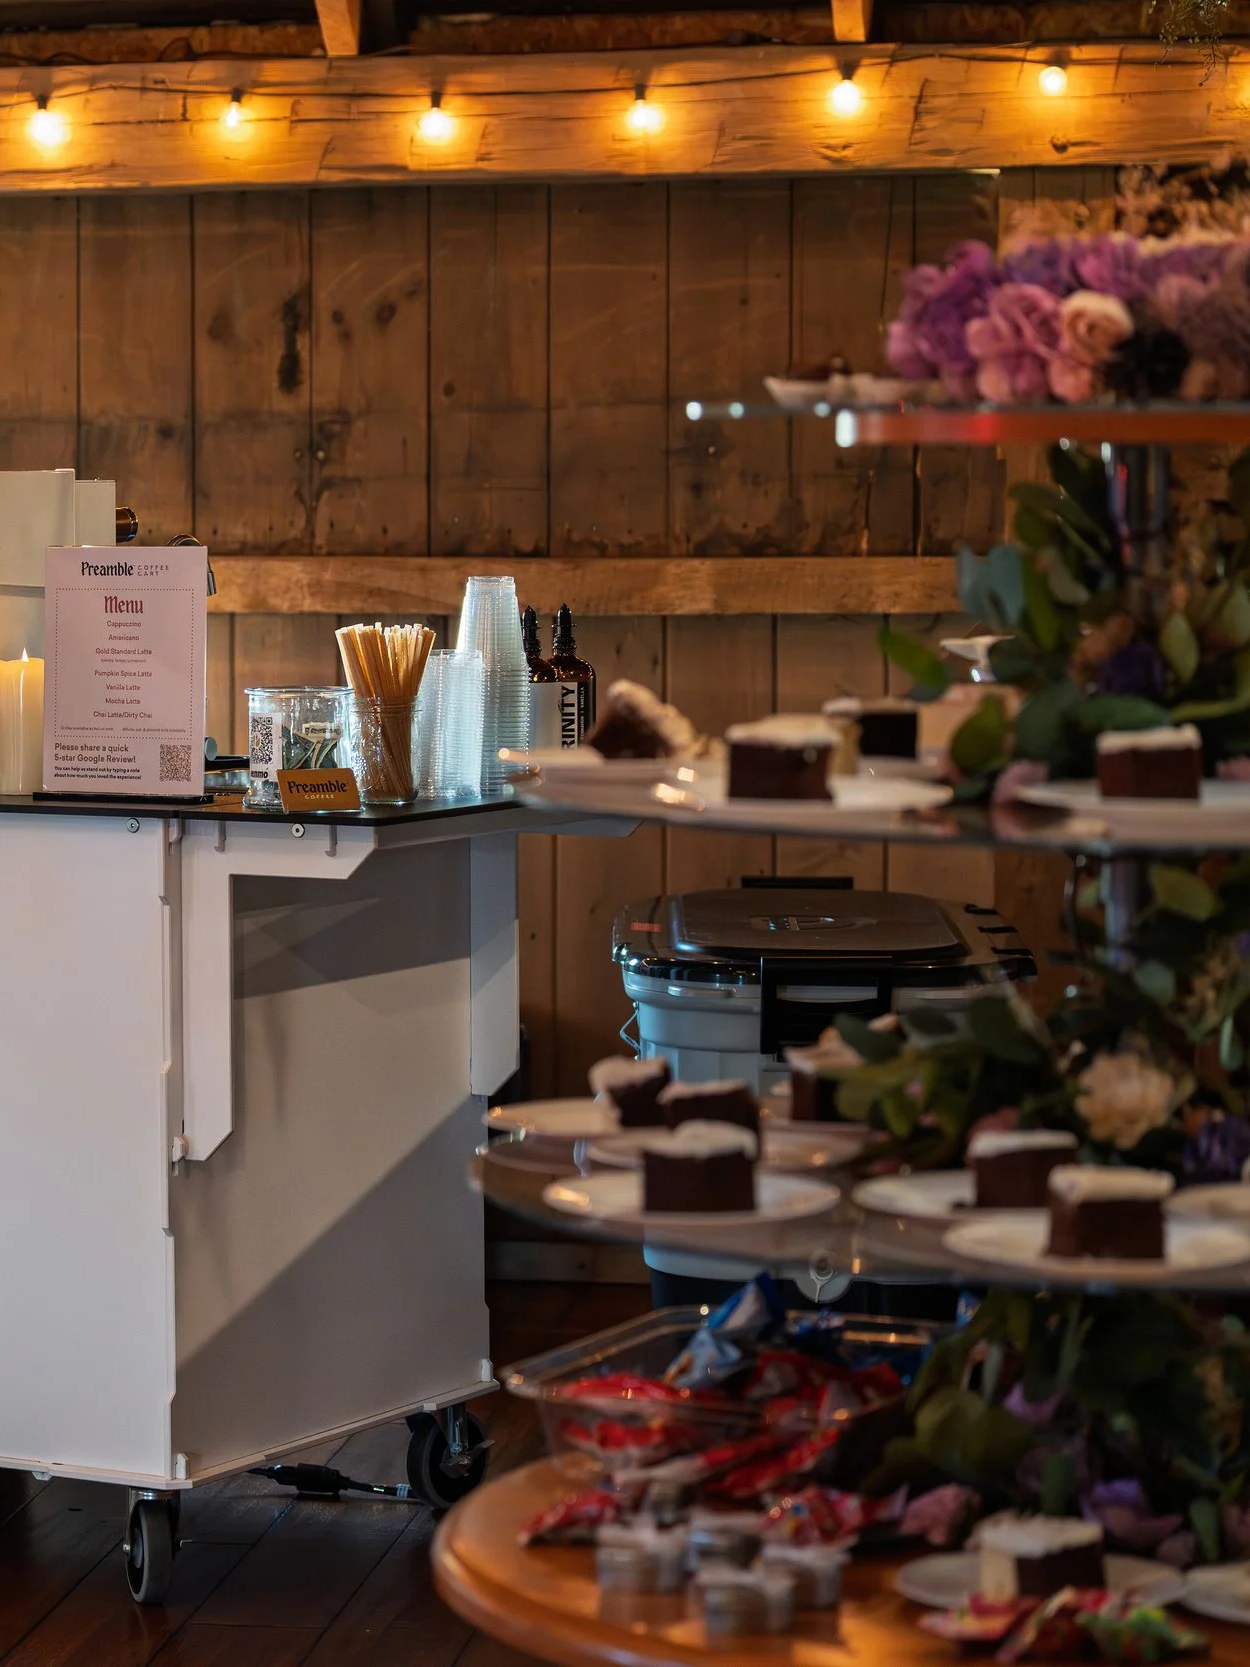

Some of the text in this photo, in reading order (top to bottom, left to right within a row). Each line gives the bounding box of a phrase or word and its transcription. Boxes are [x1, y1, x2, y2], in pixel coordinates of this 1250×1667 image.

[81, 562, 133, 576] Preamble
[104, 596, 144, 614] Menu
[107, 620, 141, 629] Cappuccino
[562, 685, 575, 749] RINITY
[55, 743, 78, 751] Please
[108, 744, 129, 753] quick
[77, 754, 104, 764] Google
[106, 755, 136, 763] Review!
[287, 780, 347, 794] Preamble
